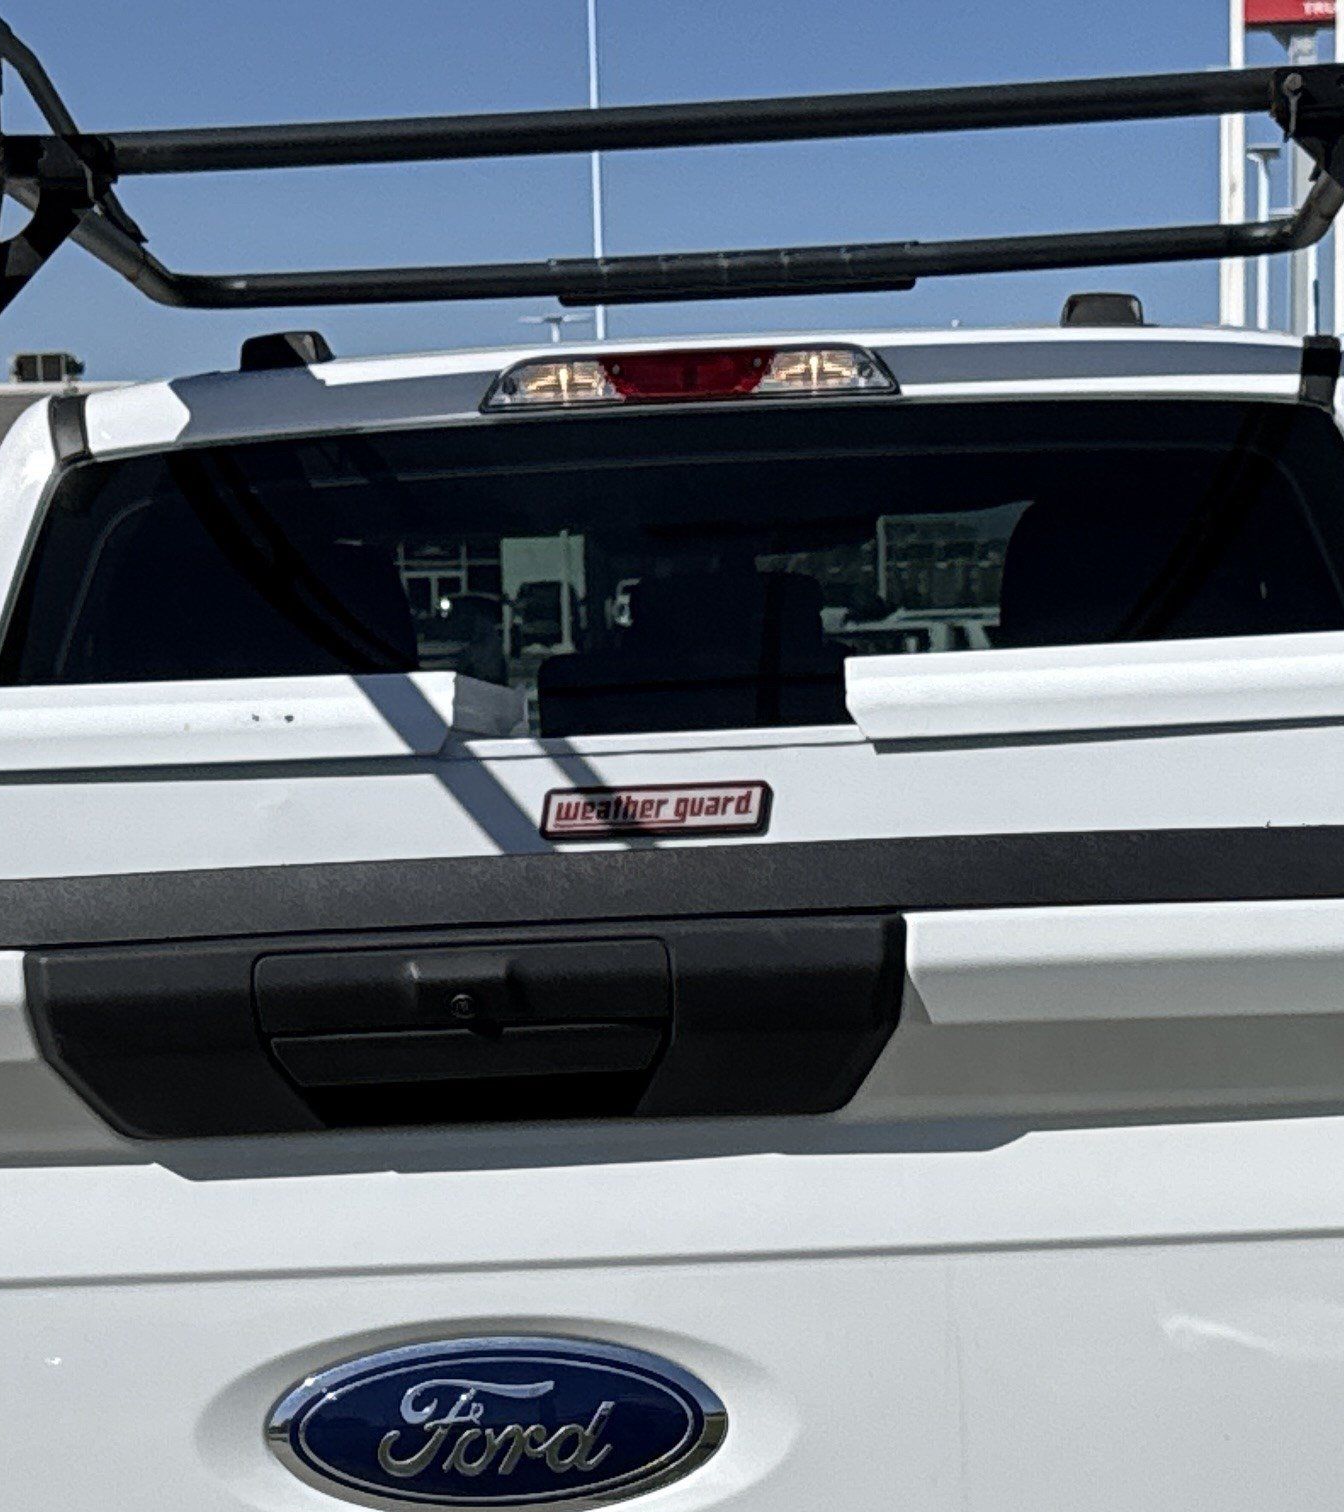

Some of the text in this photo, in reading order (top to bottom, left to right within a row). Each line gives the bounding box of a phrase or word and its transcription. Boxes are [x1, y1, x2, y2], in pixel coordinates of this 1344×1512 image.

[554, 790, 753, 825] weather guard
[377, 1378, 615, 1478] Ford
